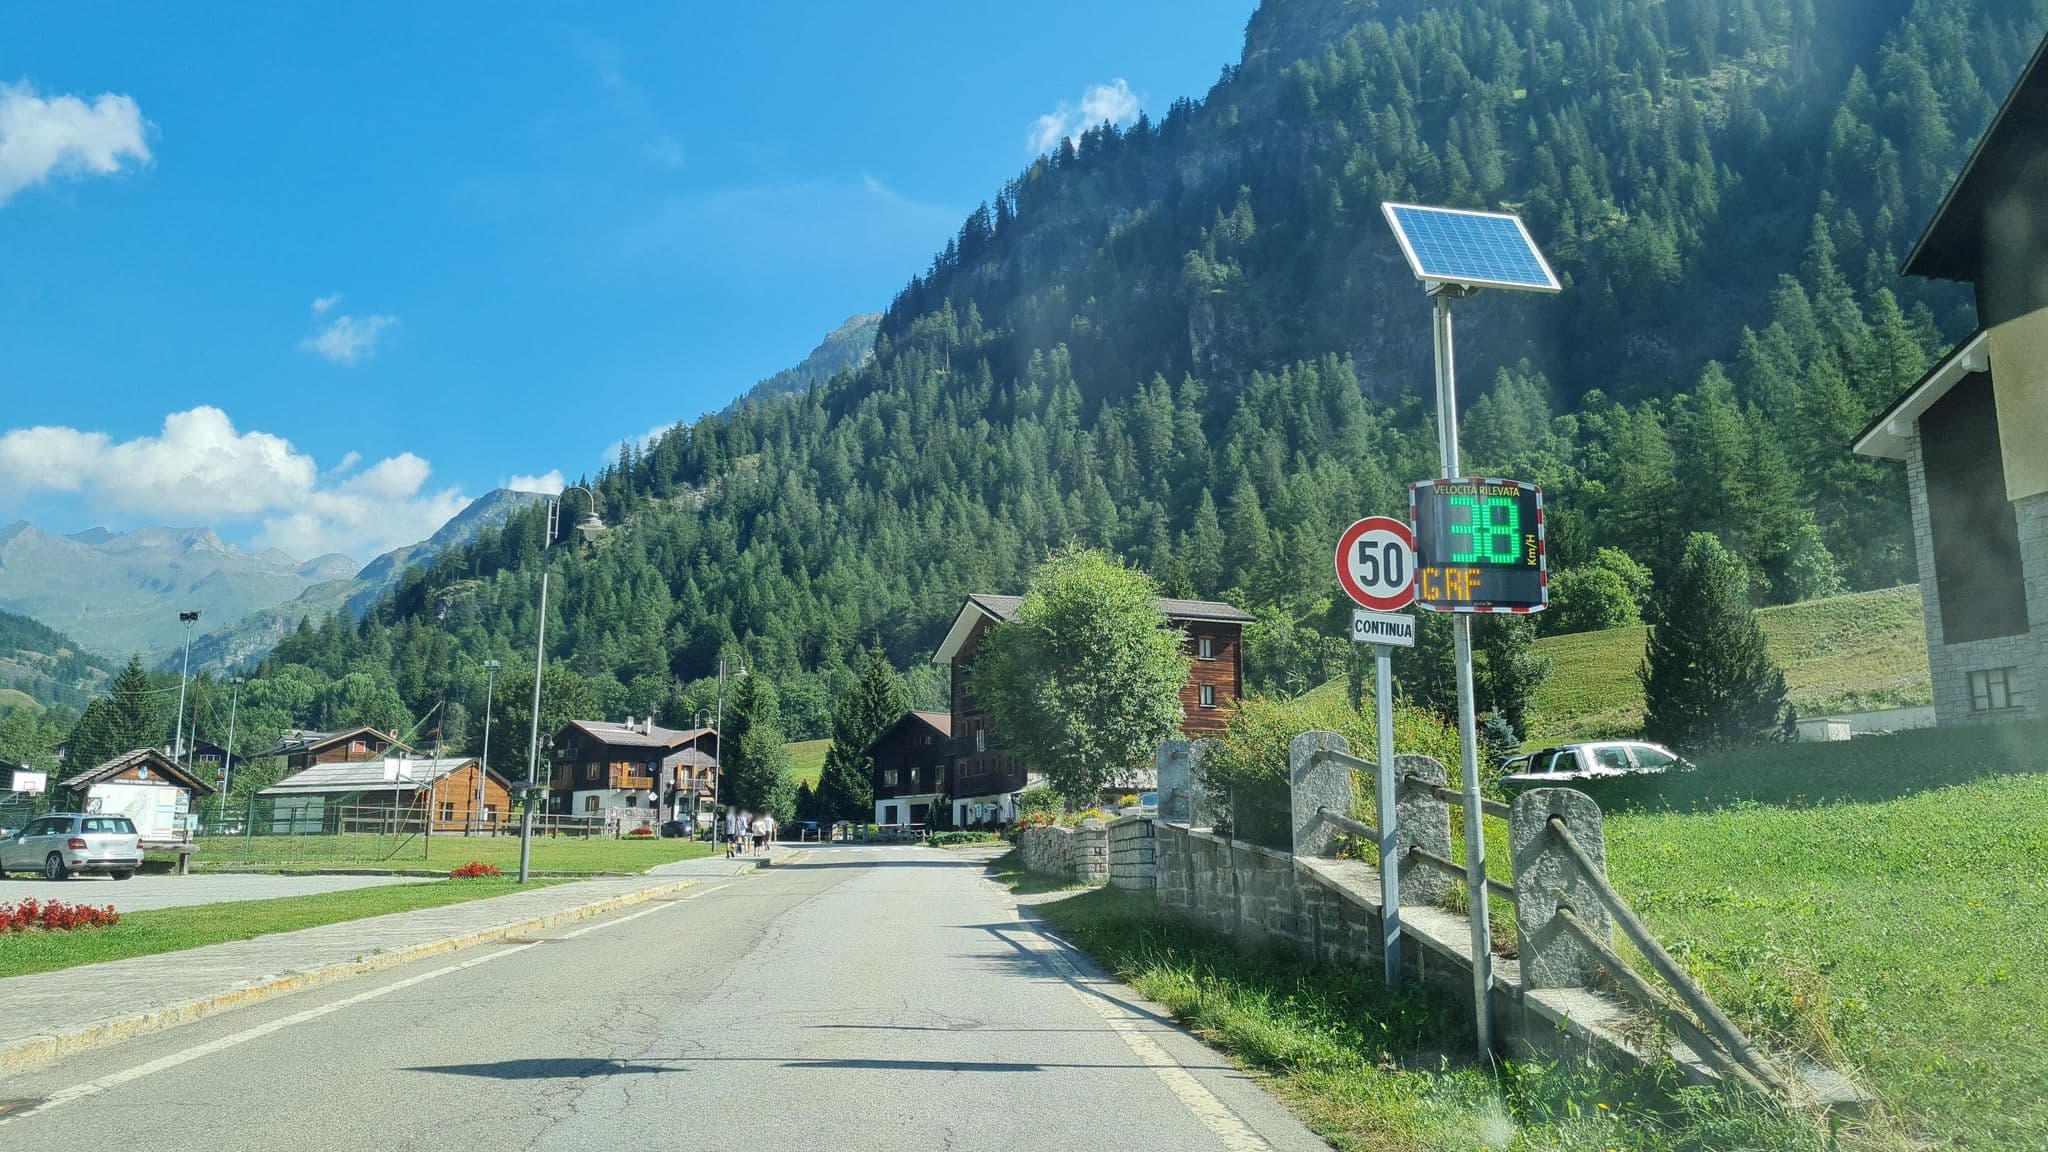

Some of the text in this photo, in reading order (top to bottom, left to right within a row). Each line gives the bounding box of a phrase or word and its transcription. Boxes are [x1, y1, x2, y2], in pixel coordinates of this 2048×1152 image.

[1480, 486, 1520, 497] RILEVATA
[1449, 496, 1520, 564] 38
[1358, 541, 1404, 588] 50
[1527, 534, 1537, 566] Km/H
[1355, 619, 1412, 639] CONTINUA
